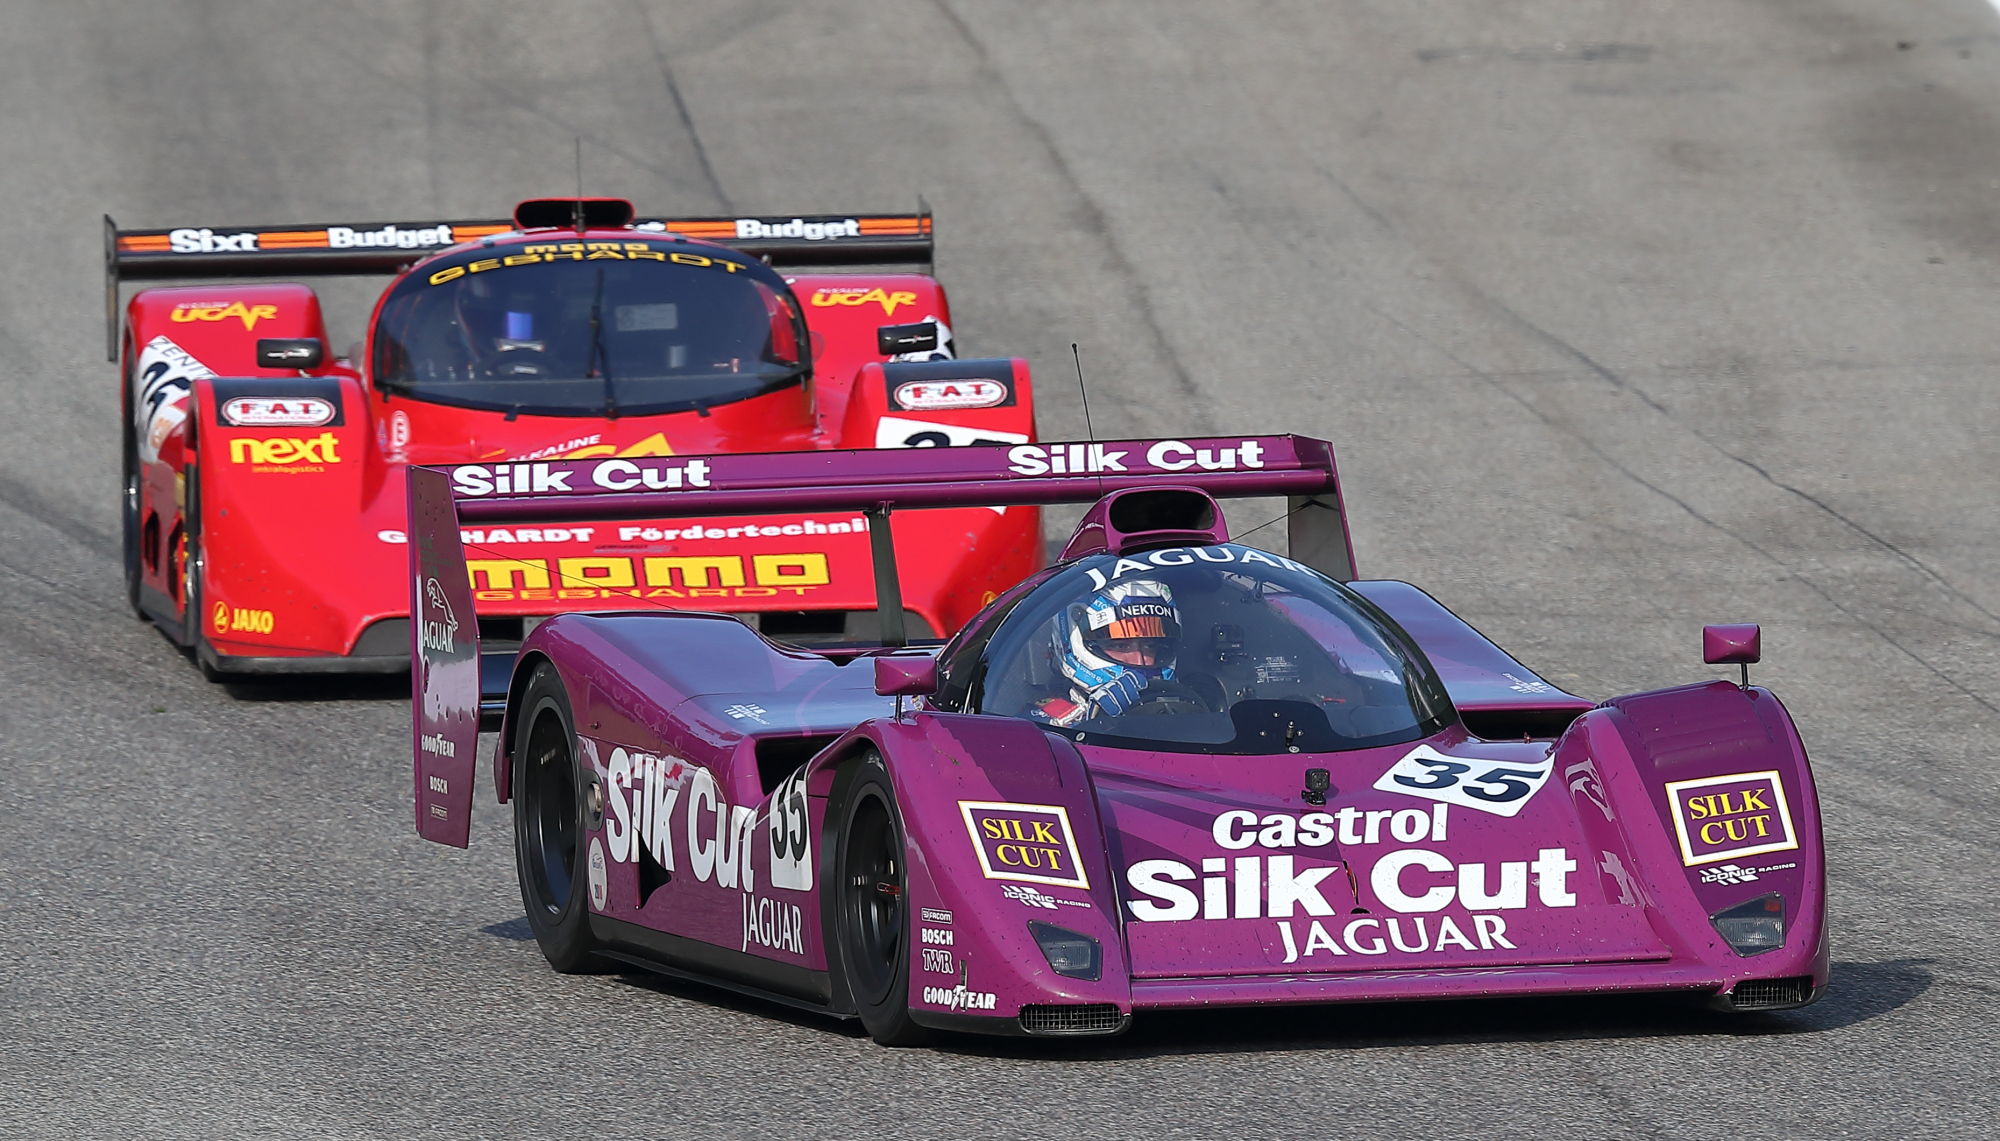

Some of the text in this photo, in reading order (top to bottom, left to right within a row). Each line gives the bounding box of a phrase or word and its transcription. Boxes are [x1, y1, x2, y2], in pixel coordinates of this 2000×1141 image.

[169, 224, 454, 253] Sixt Budget
[734, 218, 860, 241] Budget
[524, 243, 649, 255] momo
[429, 249, 747, 286] GEBHARDT
[171, 301, 278, 331] UCAR
[811, 288, 917, 317] UCAR
[229, 432, 341, 464] next
[1007, 439, 1265, 476] Silk Cut
[452, 458, 712, 496] Silk Cut
[377, 527, 595, 545] GHARDT
[466, 553, 830, 589] momo
[1083, 547, 1318, 592] JAGUAR
[476, 586, 817, 602] GEBHARDT
[231, 607, 275, 635] JAKO
[1120, 604, 1173, 618] NEKTON
[422, 620, 454, 653] AGUAR
[421, 733, 455, 758] GOODYEAR
[429, 775, 448, 795] BOSCH
[1392, 758, 1546, 803] 35
[1687, 788, 1772, 822] SILK
[606, 747, 758, 893] Silk Cut
[981, 816, 1062, 845] SILK
[1212, 803, 1449, 850] Castrol
[1699, 814, 1772, 846] CUT
[996, 844, 1063, 871] CUT
[1126, 847, 1577, 922] Silk Cut
[1701, 862, 1797, 883] ICONIC RACING
[1003, 891, 1092, 908] ICONIC RACING
[741, 892, 803, 955] JAGUAR
[921, 927, 954, 946] BOSCH
[1276, 914, 1518, 964] JAGUAR
[922, 948, 955, 974] TWR
[923, 985, 997, 1011] GOODYEAR
